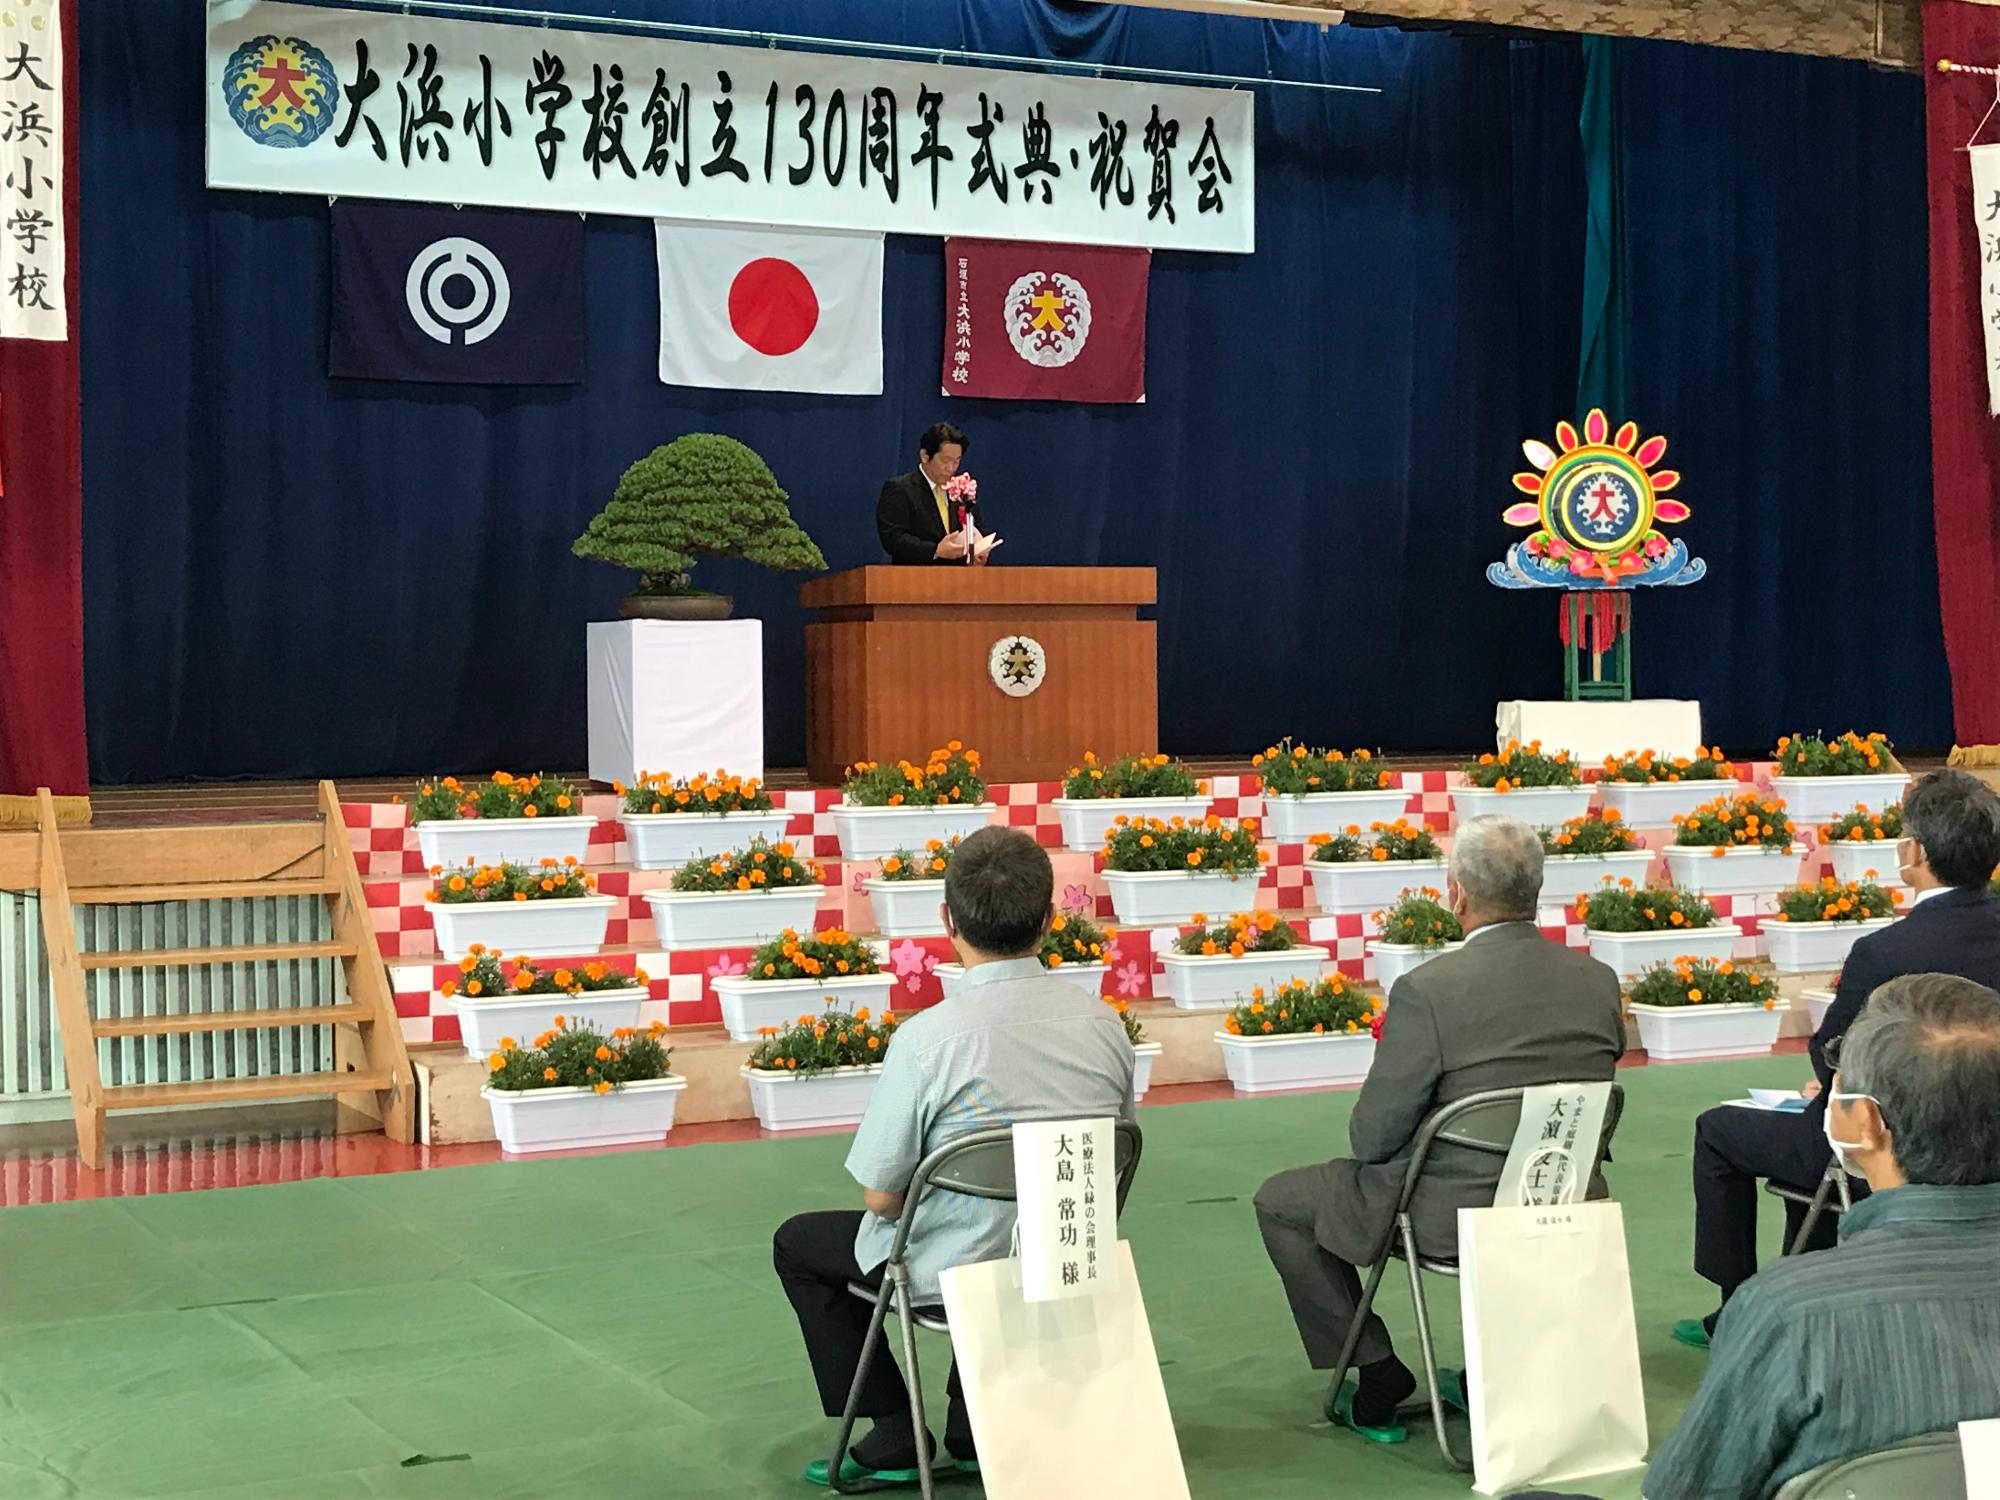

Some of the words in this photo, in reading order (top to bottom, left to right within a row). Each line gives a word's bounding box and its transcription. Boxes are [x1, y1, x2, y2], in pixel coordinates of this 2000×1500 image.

[257, 57, 306, 110] 大
[334, 38, 1232, 225] 大浜小学校創立130周年式典・祝賀会
[0, 41, 56, 311] 大浜小学校
[1030, 289, 1066, 331] 大
[1589, 483, 1617, 521] 大
[1054, 1133, 1075, 1182] 大島
[1058, 1197, 1077, 1247] 常功
[1061, 1261, 1079, 1286] 様
